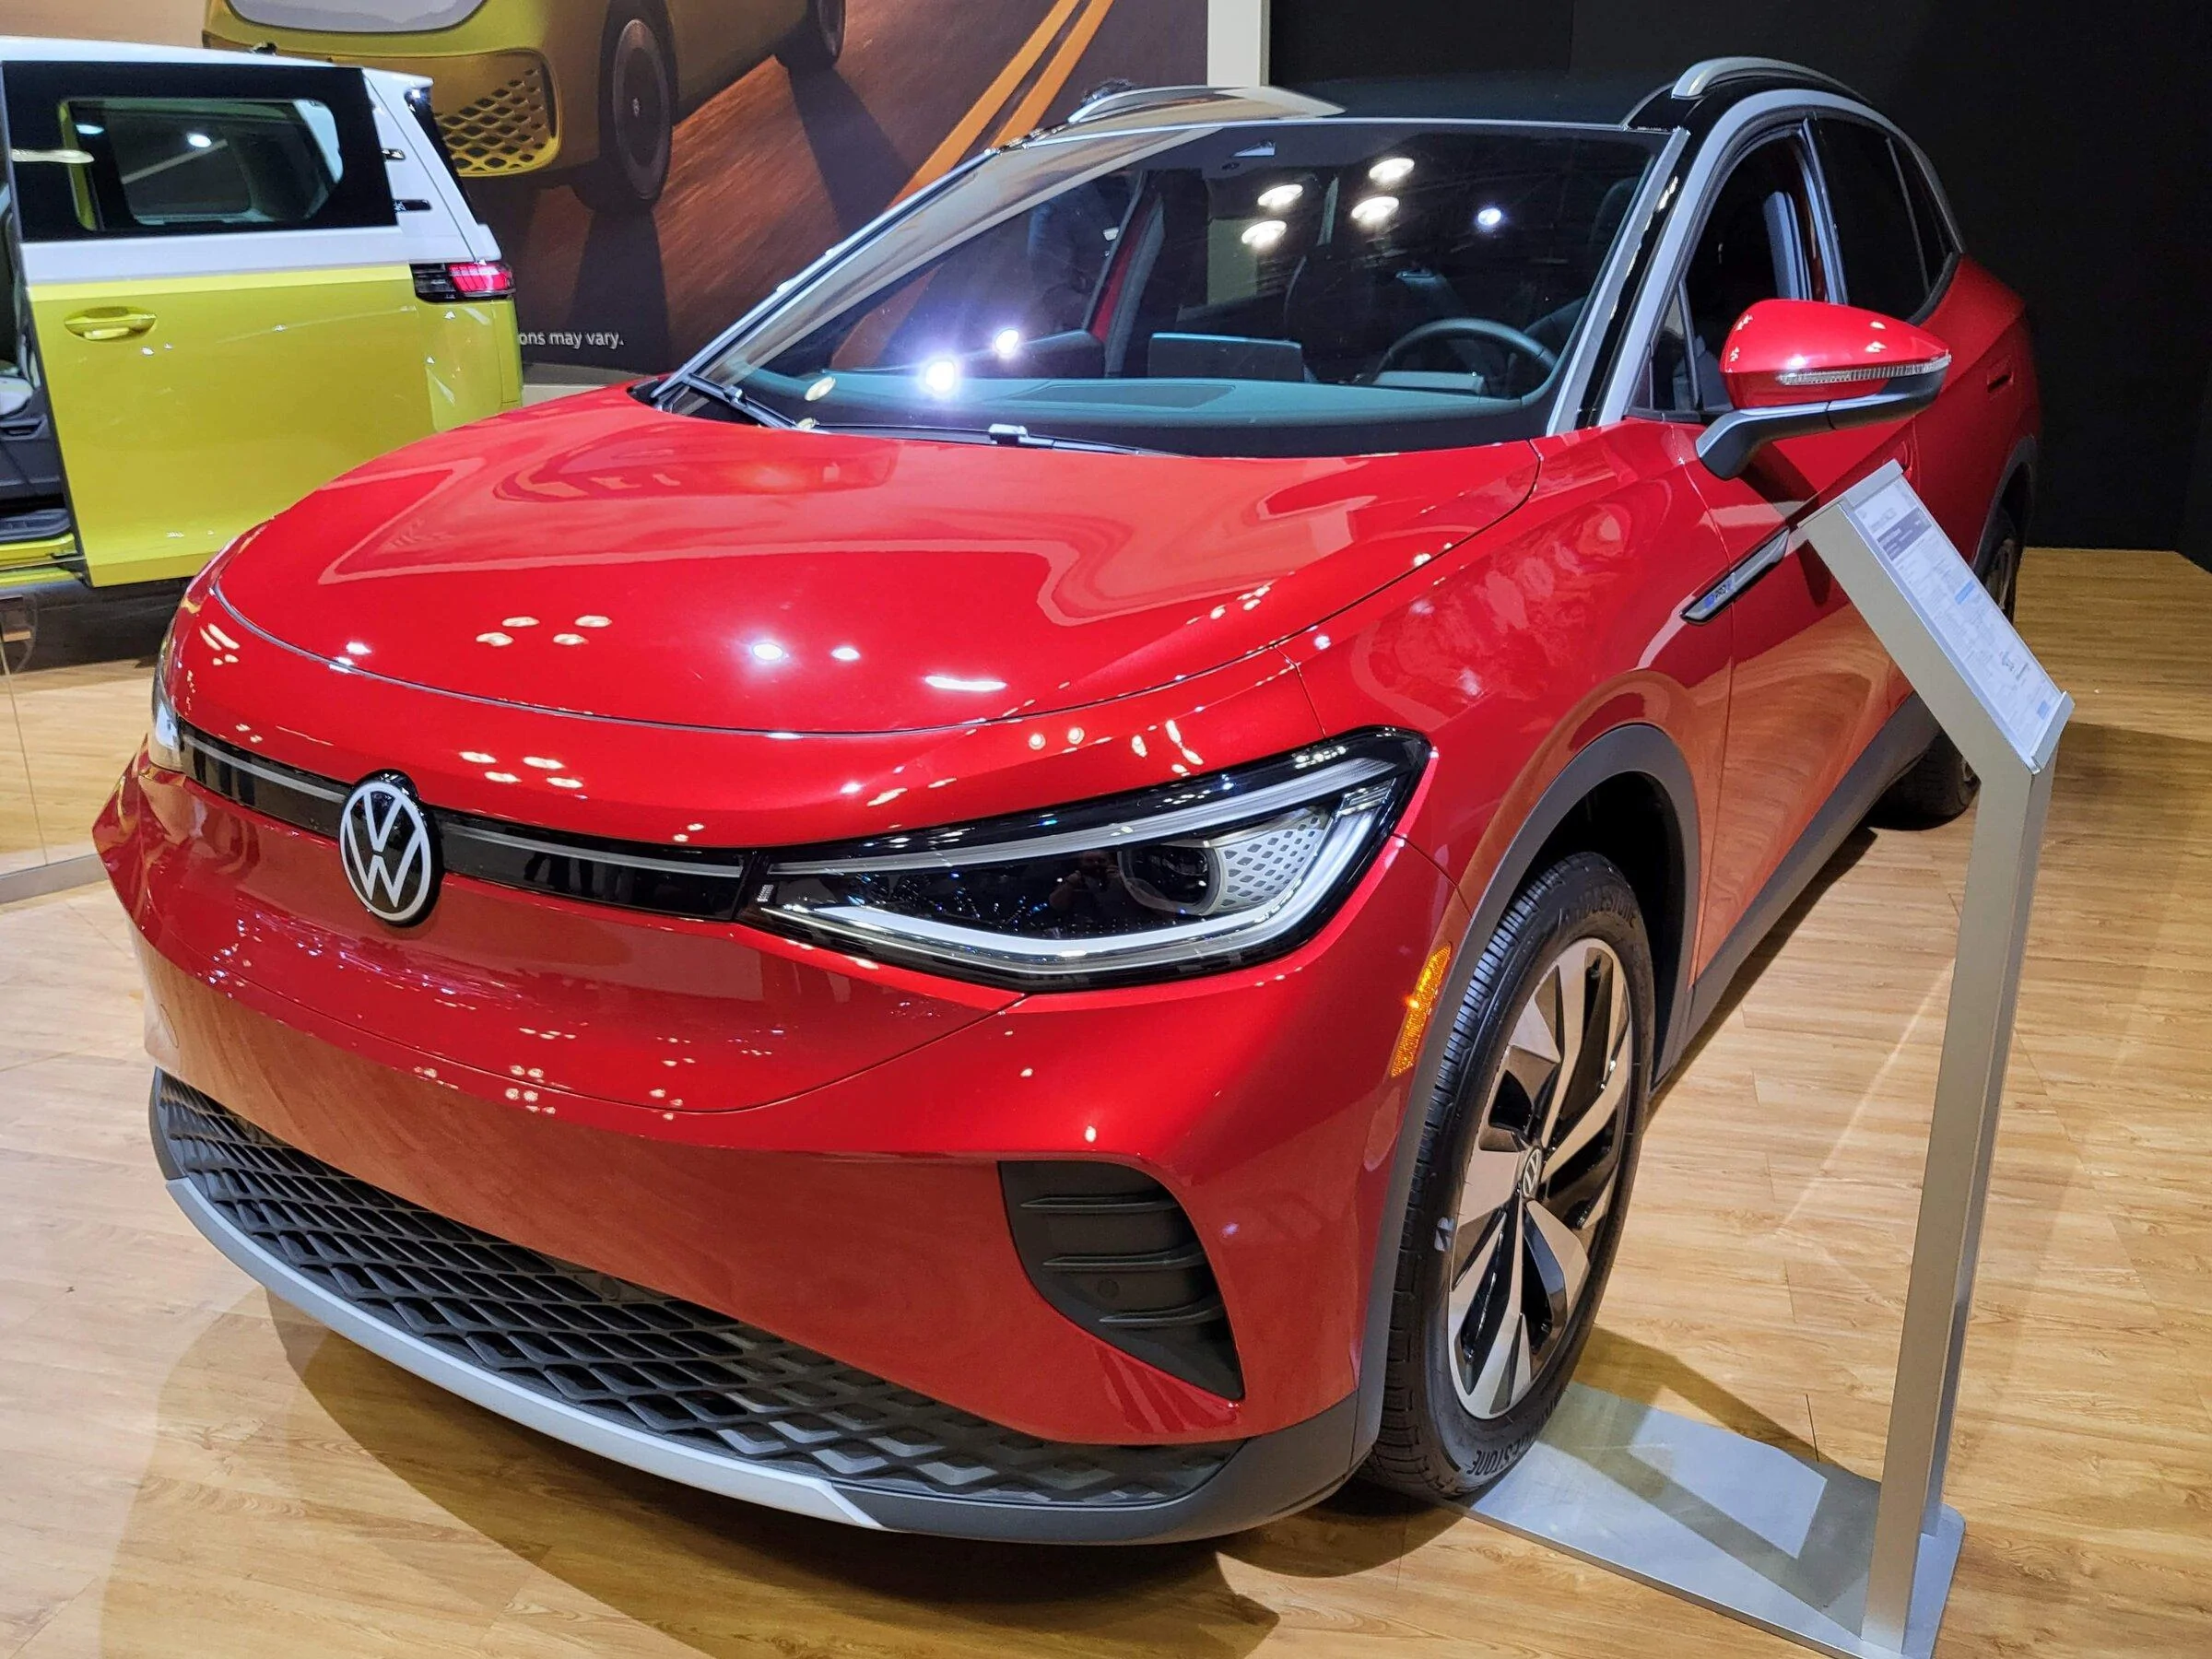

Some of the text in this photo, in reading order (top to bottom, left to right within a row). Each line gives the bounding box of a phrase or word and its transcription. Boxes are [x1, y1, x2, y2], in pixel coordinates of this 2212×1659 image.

[548, 332, 582, 349] may
[585, 332, 624, 349] vary.
[340, 783, 430, 918] VW
